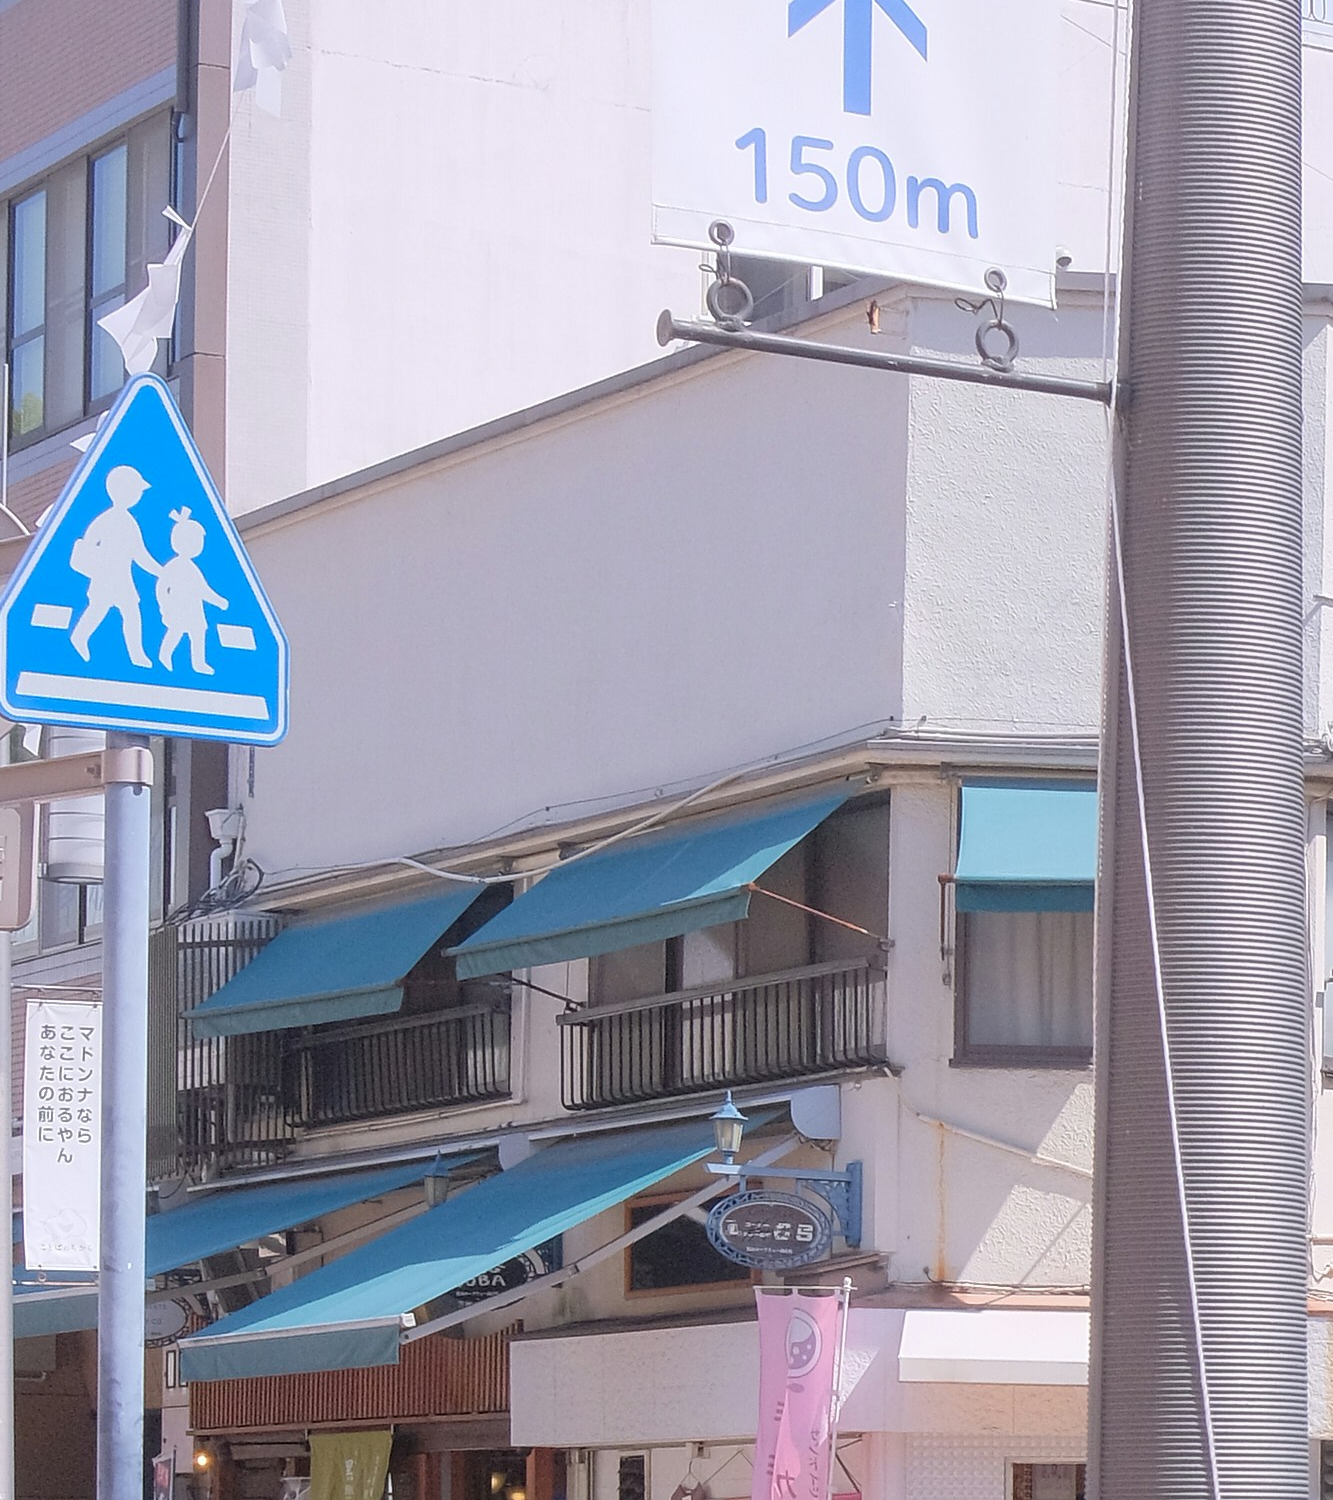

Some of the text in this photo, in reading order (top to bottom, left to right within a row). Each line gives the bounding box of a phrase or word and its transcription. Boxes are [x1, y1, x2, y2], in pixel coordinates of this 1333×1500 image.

[734, 127, 979, 240] 150m
[38, 1024, 56, 1143] あなたの前に
[57, 1025, 75, 1163] ここにおるやん
[77, 1026, 95, 1144] マドンナなら
